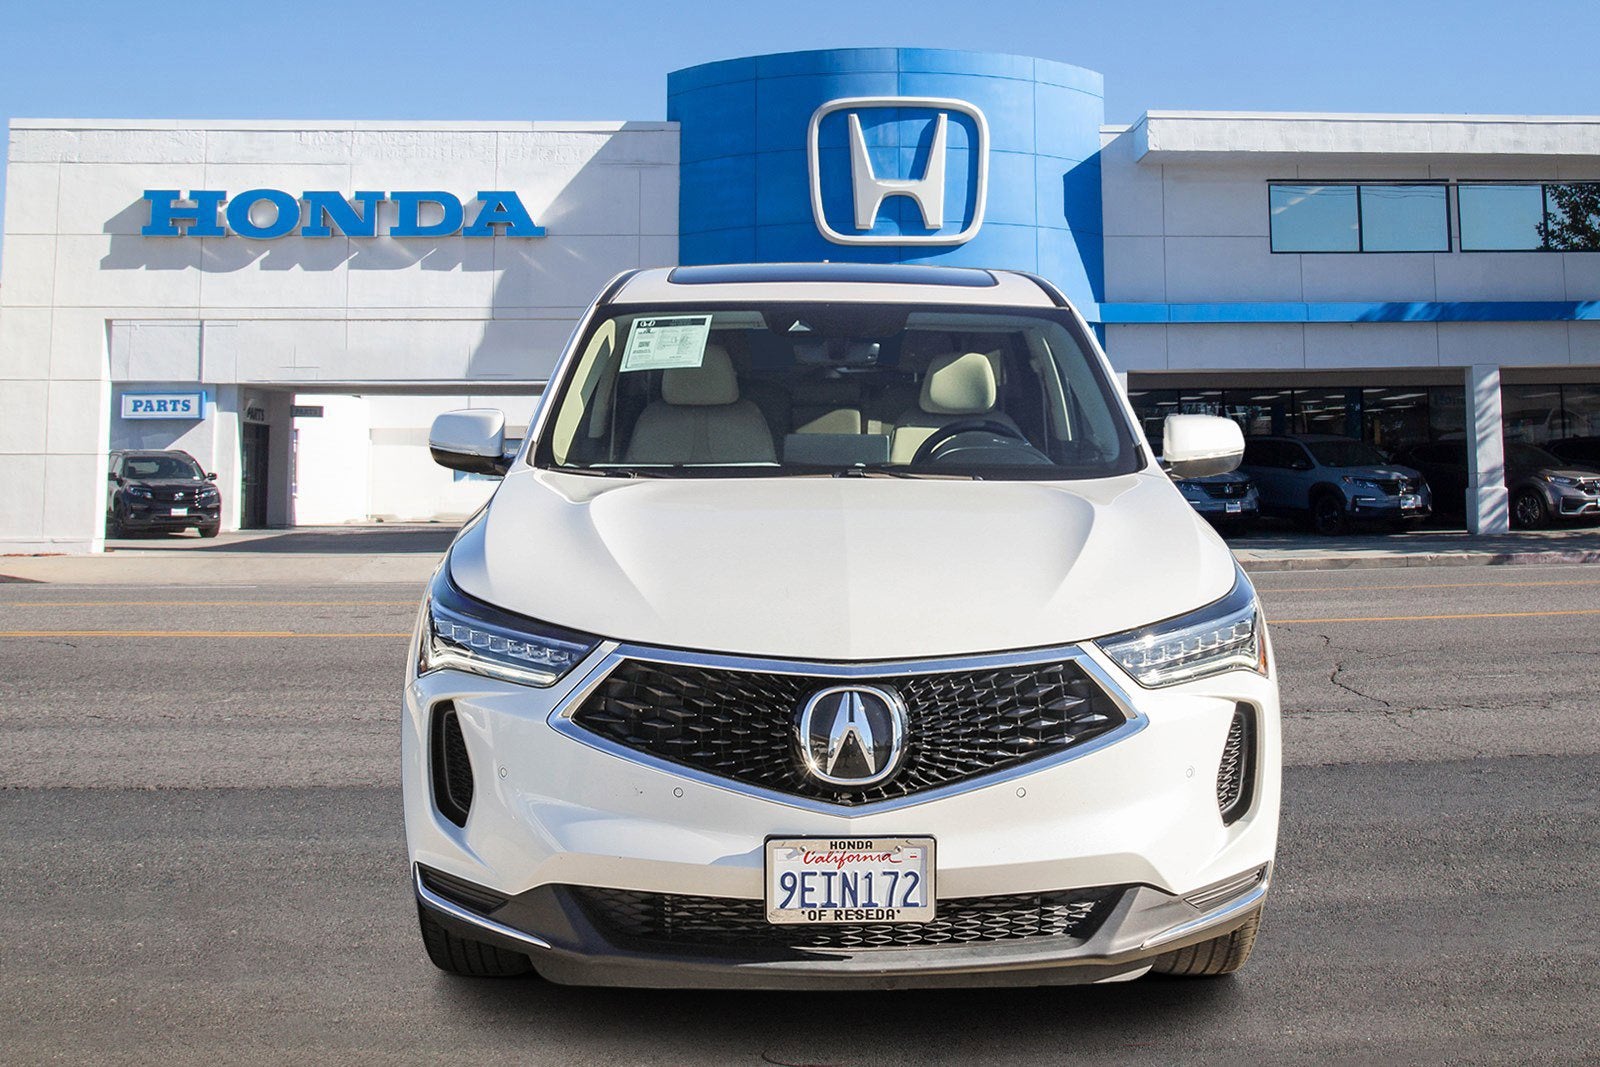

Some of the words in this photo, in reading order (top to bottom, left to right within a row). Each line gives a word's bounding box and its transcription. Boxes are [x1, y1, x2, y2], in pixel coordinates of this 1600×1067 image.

[141, 189, 547, 239] HONDA
[132, 399, 191, 412] PARTS
[829, 840, 873, 850] HONDA
[803, 850, 903, 870] California
[779, 871, 920, 909] 9EIN172
[807, 909, 827, 921] OF
[833, 908, 895, 921] RESEDA
